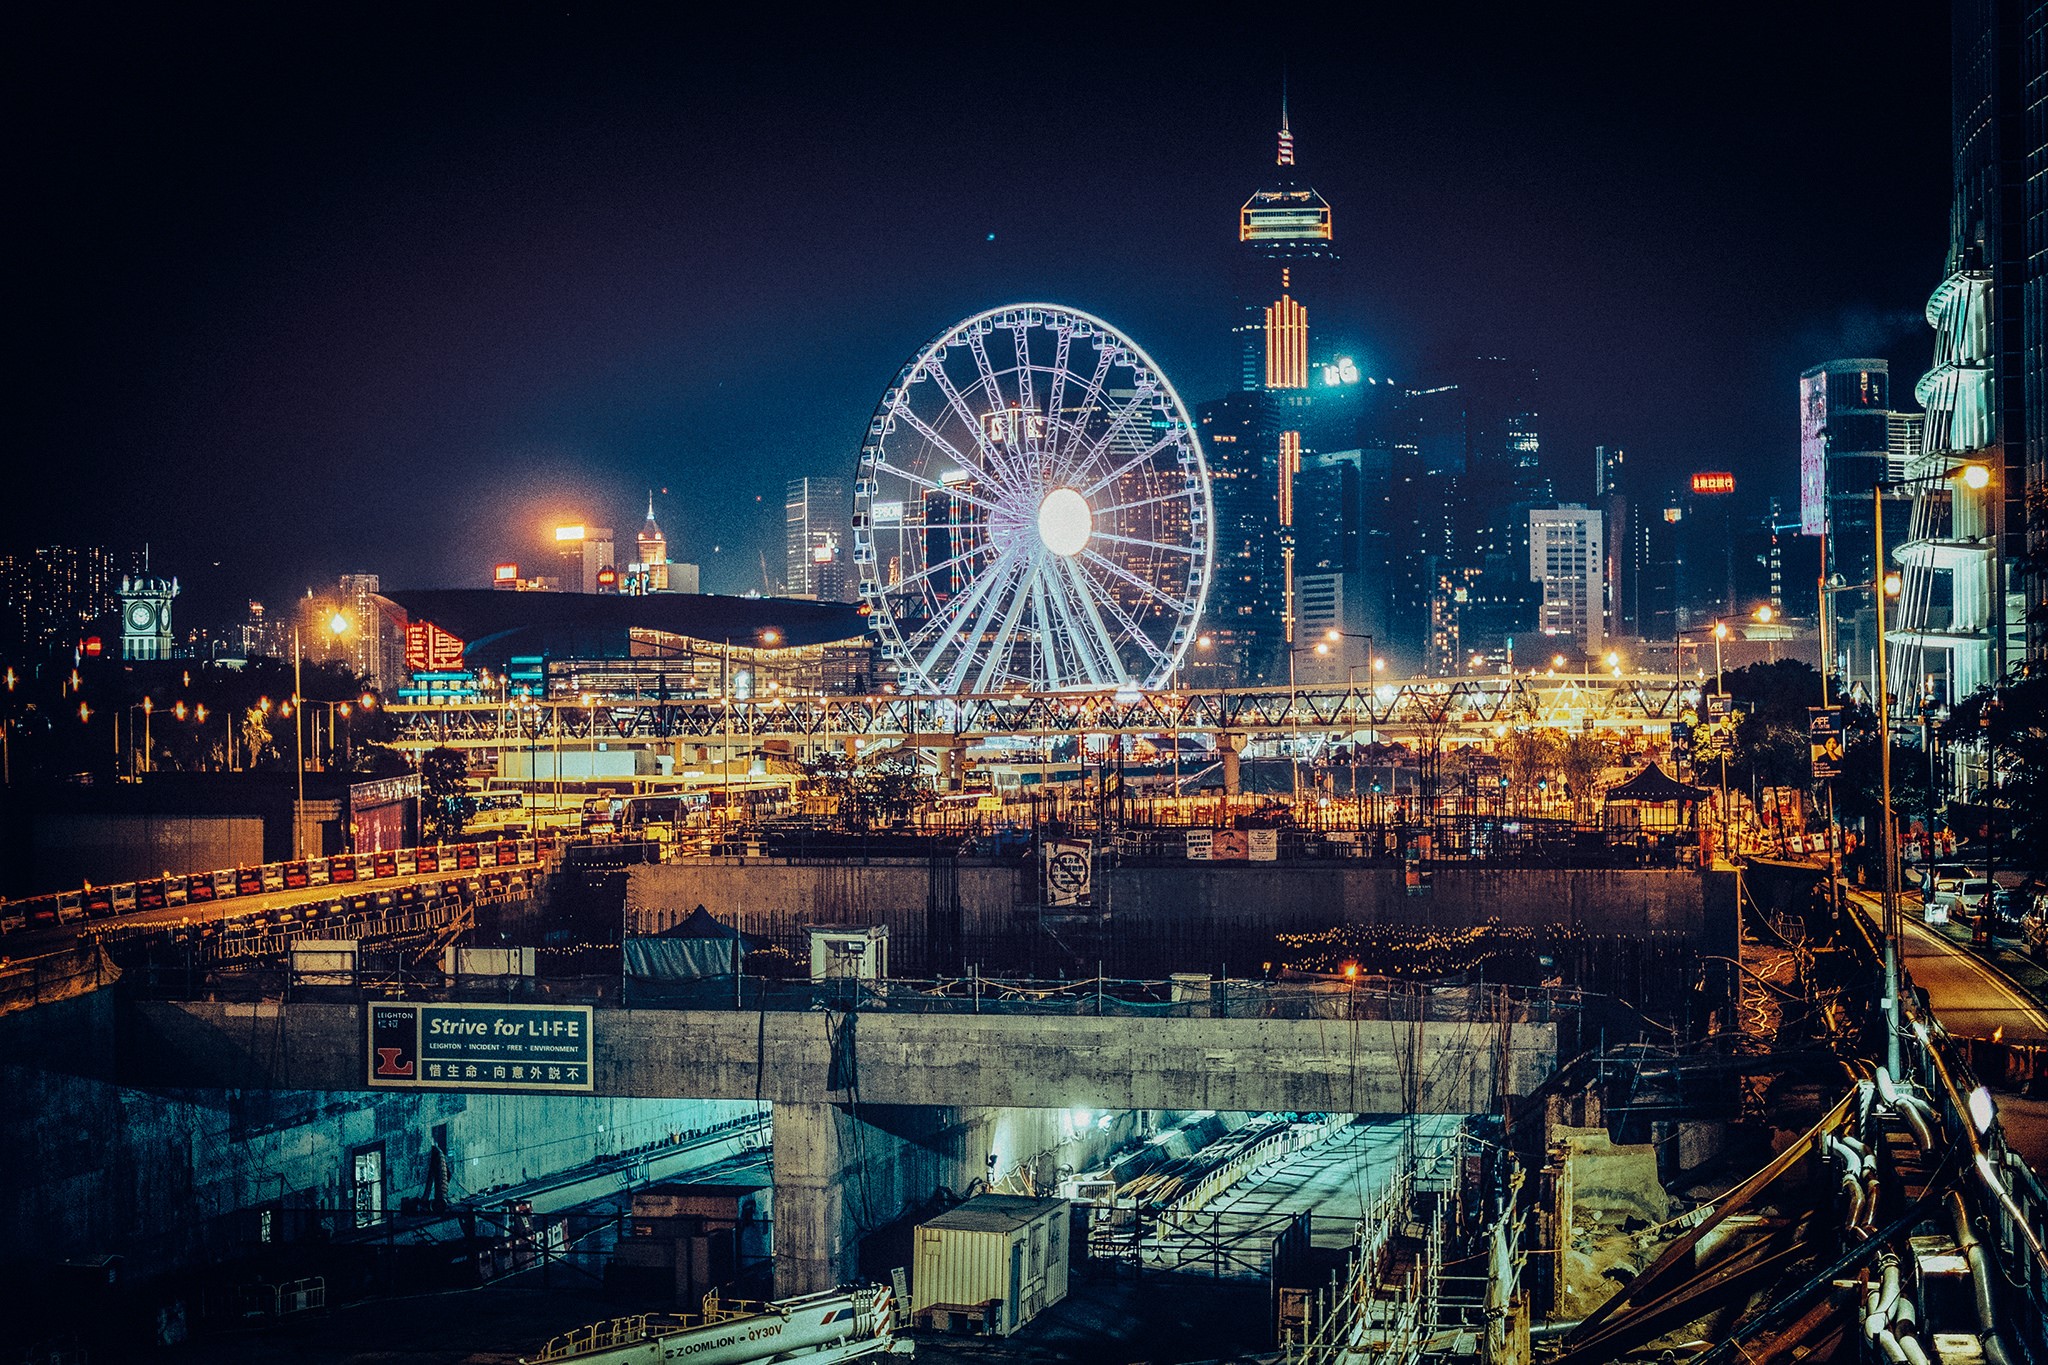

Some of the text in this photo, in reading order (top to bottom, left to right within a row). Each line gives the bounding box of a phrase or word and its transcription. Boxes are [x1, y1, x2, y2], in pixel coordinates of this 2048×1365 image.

[874, 507, 901, 518] EPSON
[430, 1018, 487, 1035] Strive
[493, 1019, 524, 1036] for
[530, 1045, 579, 1053] ENVIRONMENT
[676, 1325, 783, 1357] ZOOMLION QY30V
